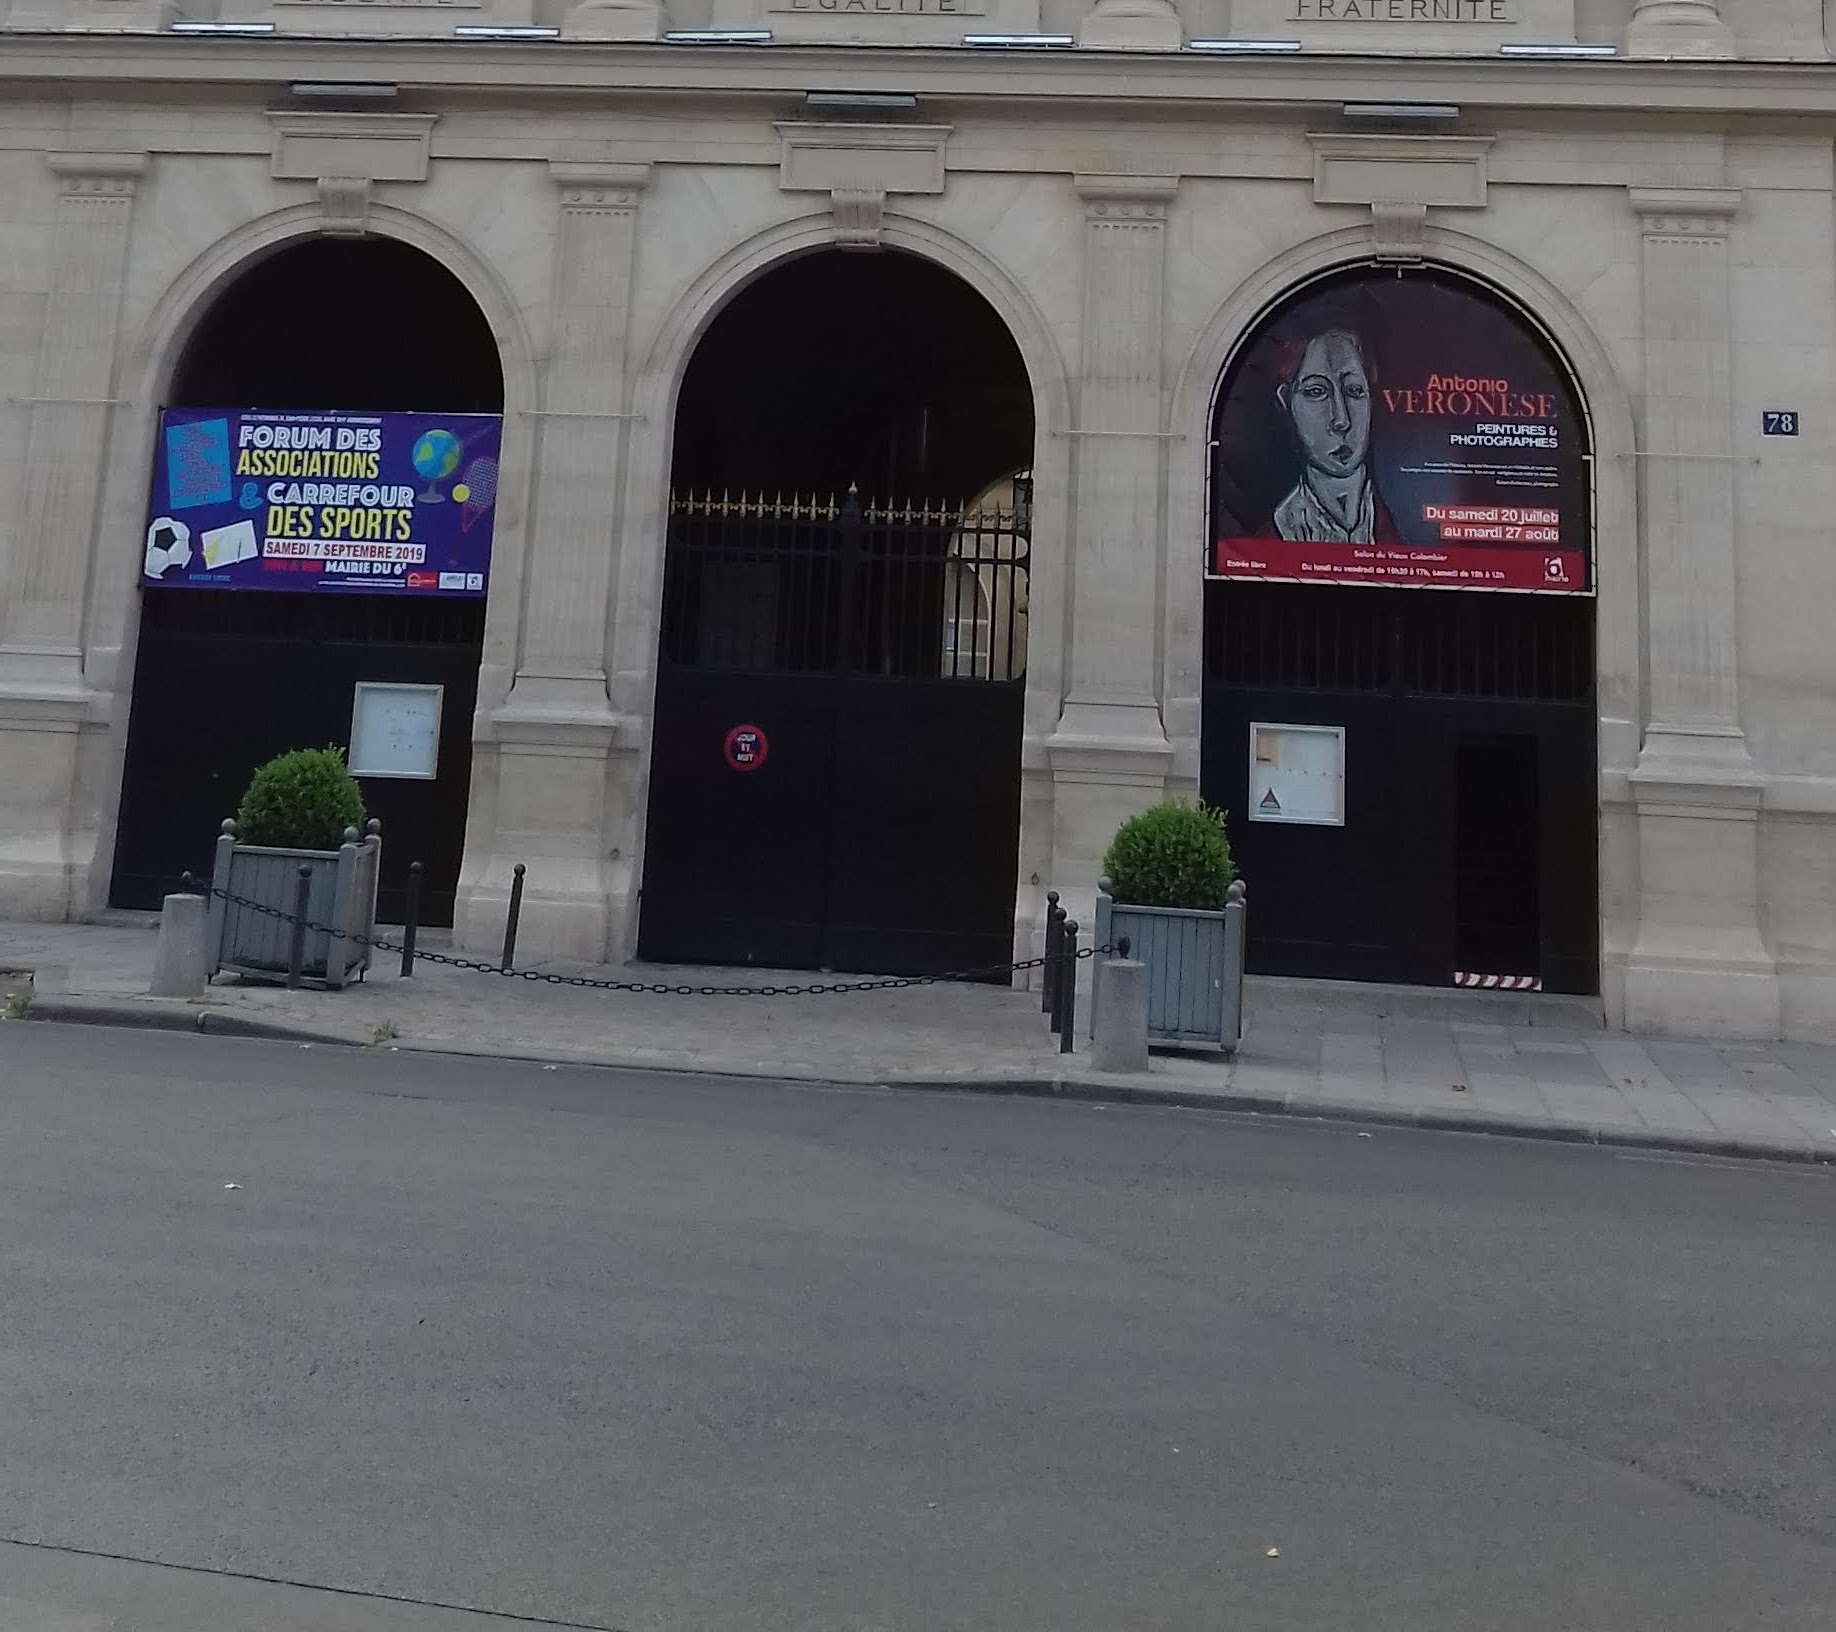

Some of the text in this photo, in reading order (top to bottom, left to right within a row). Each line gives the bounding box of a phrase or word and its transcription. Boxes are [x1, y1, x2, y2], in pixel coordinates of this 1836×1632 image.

[1428, 374, 1509, 393] Antonio
[1383, 389, 1558, 418] VERONESE
[1476, 423, 1547, 436] PEINTURES
[1767, 413, 1794, 433] 78
[238, 425, 382, 451] FORUM DES
[1450, 434, 1558, 448] PHOTOGRAPHIES
[236, 449, 381, 479] ASSOCIATIONS
[239, 482, 415, 509] & CARREFOUR
[267, 506, 412, 540] DES SPORTS
[1426, 507, 1559, 525] Du samedi 20 juillet
[1444, 526, 1559, 540] au mardi 27 août
[266, 541, 423, 560] SAMEDI 7 SEPTEMBRE 2019
[325, 560, 370, 573] MAIRIE
[372, 562, 392, 575] DU
